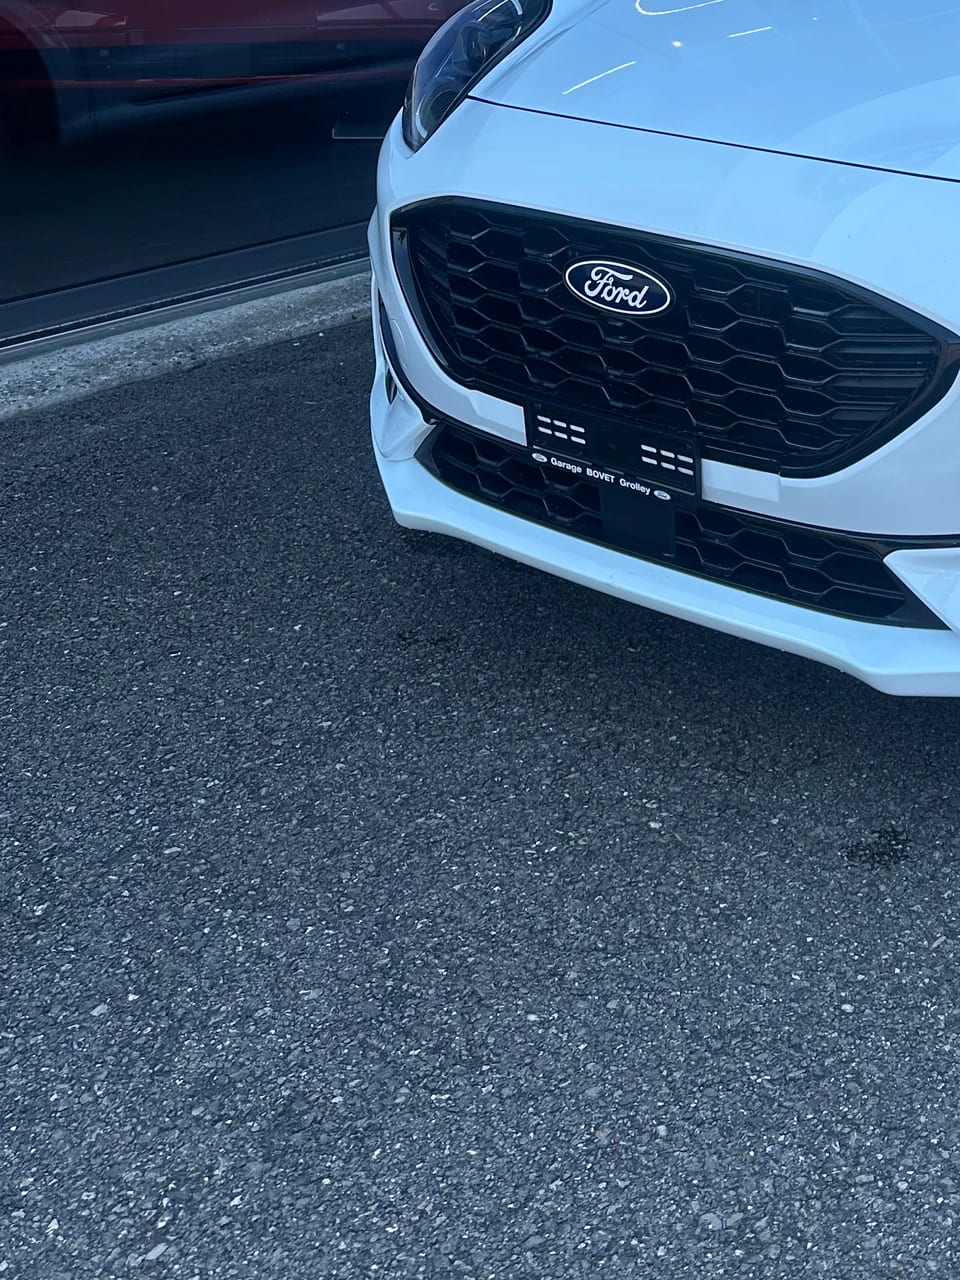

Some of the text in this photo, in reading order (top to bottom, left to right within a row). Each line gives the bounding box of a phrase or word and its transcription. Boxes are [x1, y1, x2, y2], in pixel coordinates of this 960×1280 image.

[584, 266, 650, 309] Ford
[550, 457, 582, 474] Garage
[586, 468, 615, 483] BOVET
[619, 478, 651, 495] Grolley
